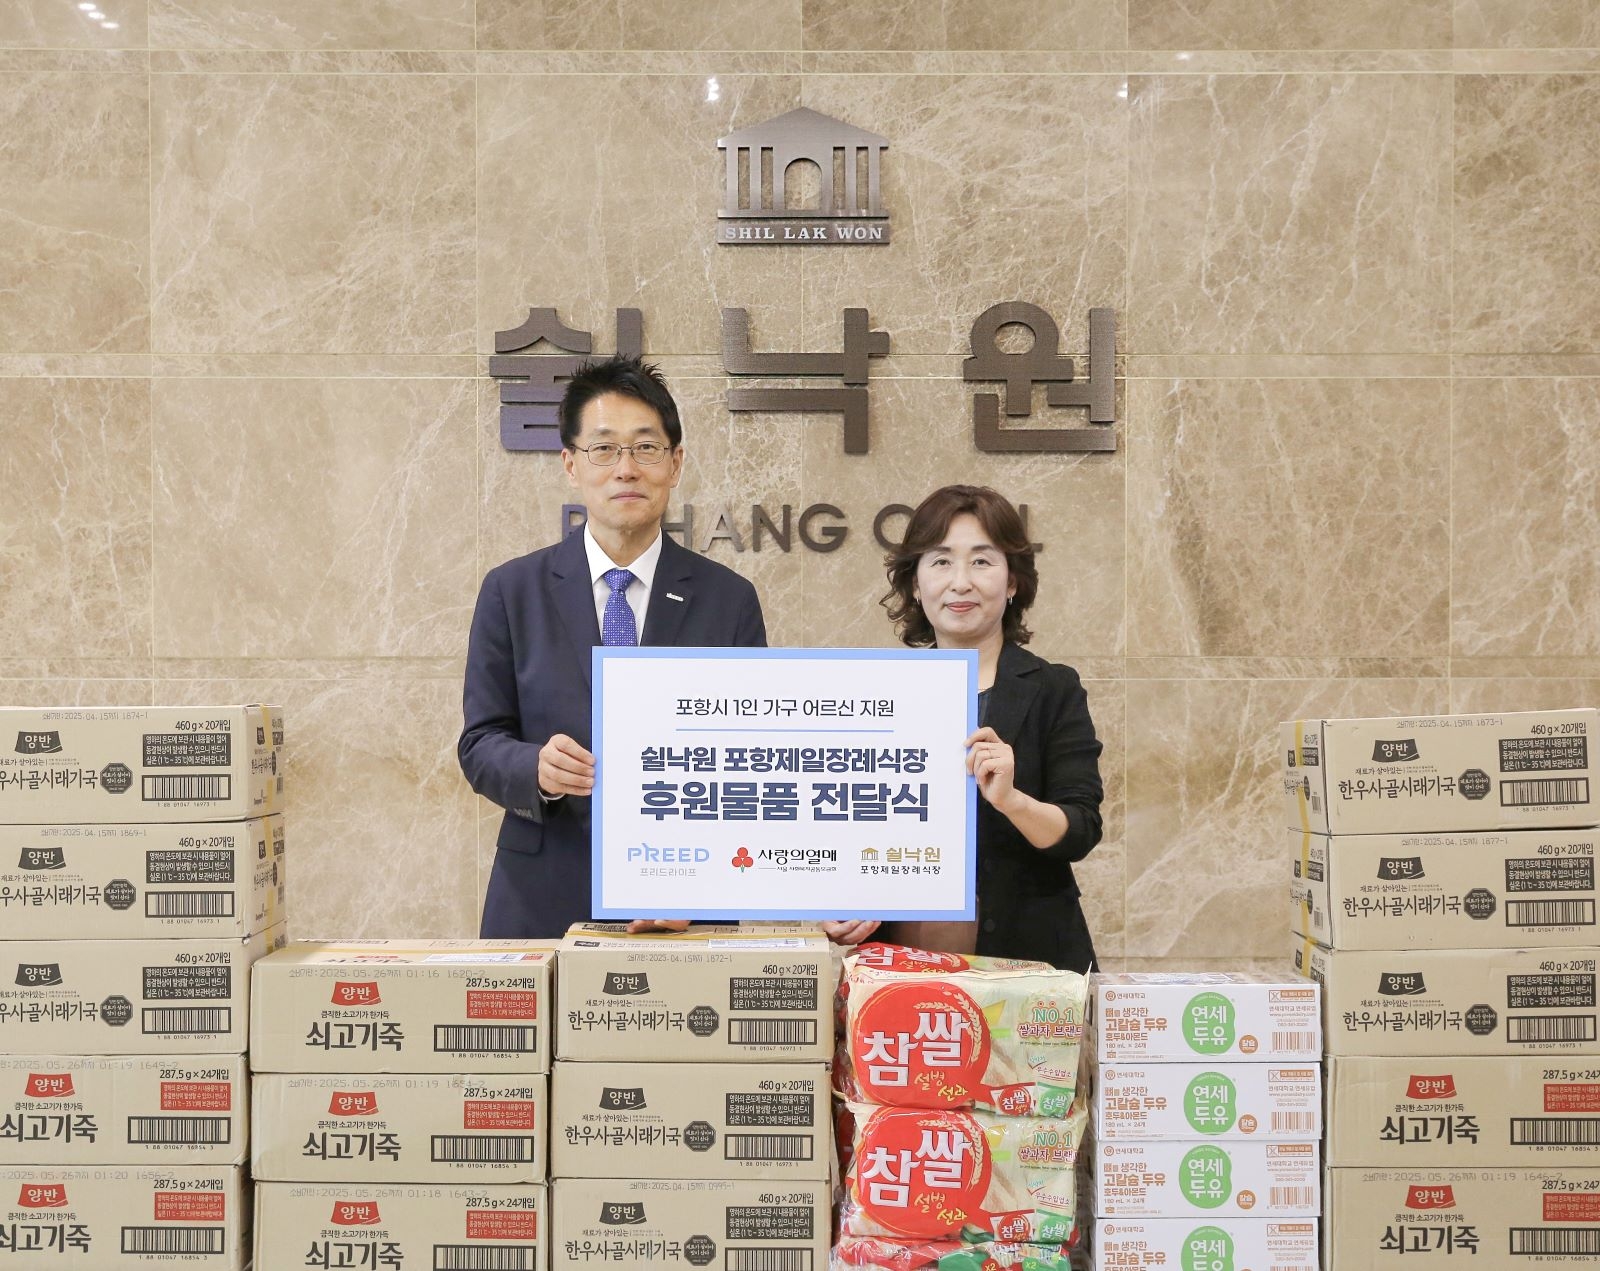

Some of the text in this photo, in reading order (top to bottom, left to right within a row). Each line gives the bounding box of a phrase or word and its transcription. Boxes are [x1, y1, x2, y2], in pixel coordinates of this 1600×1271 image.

[725, 227, 884, 240] SHIL LAK WON
[561, 503, 848, 554] PHANG
[676, 699, 894, 718] 포항시 1인 가구 어르신 지원
[25, 734, 51, 748] 양반
[1381, 742, 1408, 757] 양반
[18, 757, 44, 765] 살아있는
[641, 747, 928, 773] 쉴낙원 포항제일장례식장
[1356, 767, 1374, 775] 재료가
[1376, 766, 1402, 774] 살아있는
[0, 768, 98, 791] 우사골시래기국
[1338, 775, 1457, 801] 한우사골시래기국
[641, 780, 928, 821] 후원물품 전달식
[28, 850, 55, 865] 양반
[627, 843, 710, 863] PREED
[758, 848, 837, 866] 사랑의열매
[886, 847, 940, 862] 쉴낙원
[640, 868, 696, 876] 프리드라이프
[860, 865, 941, 874] 포항제일장례식장
[1387, 860, 1414, 875] 양반
[1, 874, 48, 882] 재료가 살아있는
[0, 885, 102, 907] 우사골시래기국
[1360, 884, 1407, 893] 재료가 살아있는
[1342, 894, 1462, 919] 한우사골시래기국
[25, 967, 51, 981] 양반
[613, 976, 639, 990] 양반
[1388, 976, 1415, 990] 양반
[18, 990, 45, 998] 살아있는
[341, 986, 371, 1000] 양반
[586, 999, 603, 1007] 재료가
[606, 999, 632, 1007] 살아있는
[1361, 999, 1408, 1008] 재료가 살아있는
[0, 1001, 99, 1023] 우사골시래기국
[321, 1011, 389, 1019] 큼직한 소고기가 한가득
[1035, 1008, 1073, 1023] NO.1
[1122, 1007, 1148, 1017] 생각한
[1192, 1006, 1226, 1025] 연세
[568, 1011, 685, 1032] 한우사골시래기국
[1105, 1018, 1167, 1031] 고칼슘 두유
[1343, 1010, 1463, 1033] 한우사골시래기국
[306, 1022, 404, 1051] 쇠고기죽
[1019, 1024, 1050, 1037] 쌀과자
[1105, 1033, 1148, 1041] 호두&아몬드
[1192, 1027, 1227, 1046] 두유
[861, 1012, 970, 1087] 참쌀
[35, 1078, 65, 1092] 양반
[915, 1072, 945, 1090] 설병
[1416, 1079, 1446, 1094] 양반
[609, 1091, 635, 1105] 양반
[938, 1085, 968, 1101] 선과
[1122, 1086, 1147, 1096] 생각한
[1193, 1085, 1227, 1104] 연세
[15, 1102, 83, 1111] 큼직한 소고기가 한가득
[338, 1096, 368, 1110] 양반
[1002, 1092, 1026, 1110] 참쌀
[1043, 1096, 1067, 1109] 참쌀
[1105, 1097, 1167, 1110] 고칼슘 두유
[1396, 1104, 1465, 1112] 큼직한 소고기가 한가득
[1105, 1112, 1147, 1120] 호두&아몬드
[1194, 1106, 1228, 1126] 두유
[0, 1113, 98, 1143] 쇠고기죽
[318, 1121, 387, 1129] 큼직한 소고기가 한가득
[1380, 1115, 1480, 1145] 쇠고기죽
[564, 1126, 682, 1148] 한우사골시래기국
[1032, 1131, 1072, 1148] NO.1
[302, 1132, 402, 1161] 쇠고기죽
[1020, 1149, 1049, 1160] 쌀과자
[861, 1130, 972, 1208] 참쌀
[1121, 1163, 1147, 1173] 생각한
[1188, 1159, 1223, 1177] 연세
[1104, 1173, 1166, 1186] 고칼슘 두유
[28, 1188, 58, 1203] 양반
[1104, 1188, 1146, 1196] 호두&아몬드
[1189, 1179, 1224, 1199] 두유
[915, 1192, 946, 1213] 설병
[1415, 1190, 1446, 1204] 양반
[8, 1213, 77, 1221] 큼직한 소고기가 한가득
[341, 1206, 371, 1220] 양반
[609, 1206, 635, 1220] 양반
[937, 1208, 967, 1225] 선과
[1395, 1214, 1464, 1223] 큼직한 소고기가 한가득
[320, 1230, 389, 1238] 큼직한 소고기가 한가득
[602, 1229, 629, 1237] 살아있는
[1002, 1220, 1025, 1238] 참쌀
[1042, 1223, 1066, 1238] 참쌀
[0, 1224, 92, 1254] 쇠고기죽
[1121, 1241, 1147, 1251] 생각한
[1379, 1225, 1480, 1257] 쇠고기죽
[305, 1241, 404, 1271] 쇠고기죽
[565, 1240, 682, 1262] 한우사골시래기국
[1191, 1240, 1225, 1258] 연세
[1104, 1252, 1166, 1265] 고칼슘 두유
